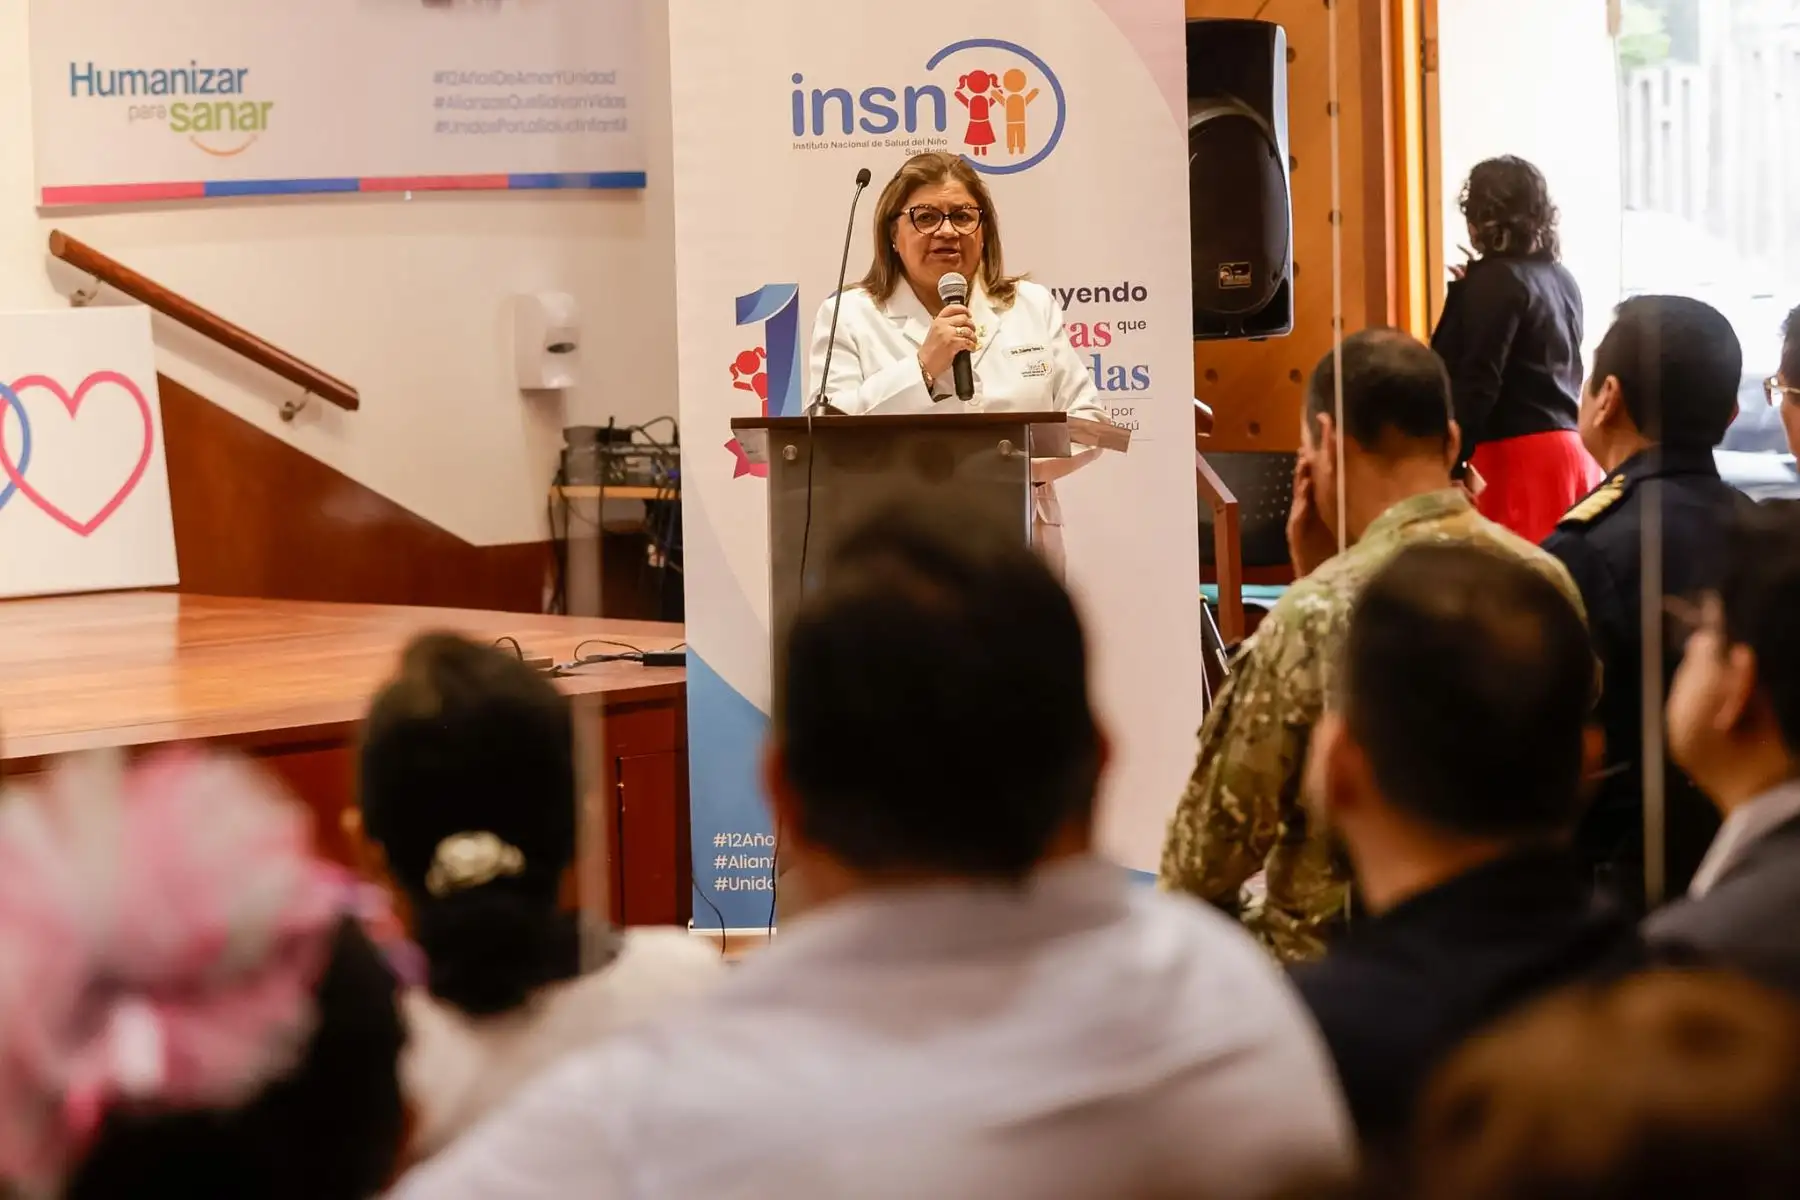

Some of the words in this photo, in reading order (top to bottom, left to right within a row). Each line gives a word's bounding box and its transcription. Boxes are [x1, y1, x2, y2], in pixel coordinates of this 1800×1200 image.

[70, 60, 248, 97] Humanizar
[128, 104, 167, 123] para
[169, 101, 274, 132] sanar
[791, 72, 947, 137] insn
[792, 141, 828, 150] Instituto
[830, 140, 869, 148] Nacional
[884, 139, 909, 147] Salud
[911, 138, 925, 146] del
[927, 137, 947, 145] Niño
[905, 148, 921, 156] San
[1062, 319, 1112, 349] as
[1117, 319, 1147, 334] que
[1111, 407, 1135, 419] por
